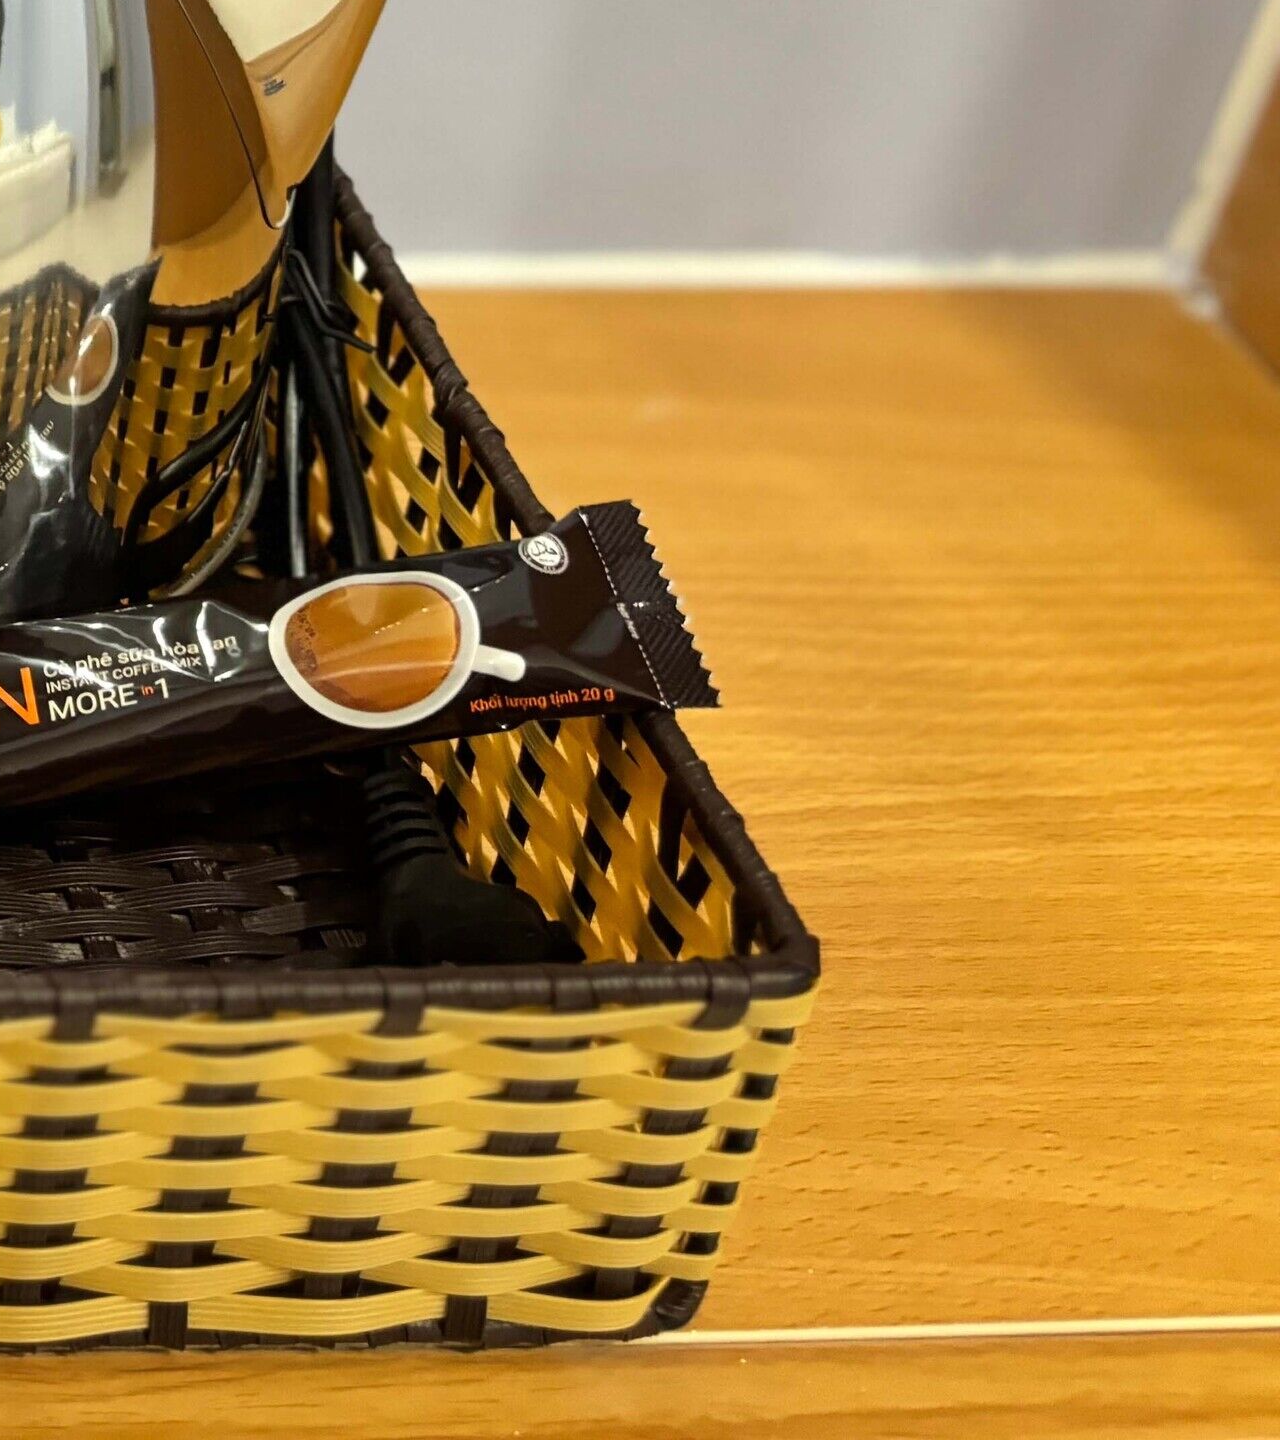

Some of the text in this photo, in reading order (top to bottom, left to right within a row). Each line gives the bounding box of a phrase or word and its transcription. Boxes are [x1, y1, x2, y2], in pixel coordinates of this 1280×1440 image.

[48, 682, 139, 722] MORE
[155, 677, 170, 700] 1
[581, 687, 601, 702] 20
[603, 687, 616, 702] g
